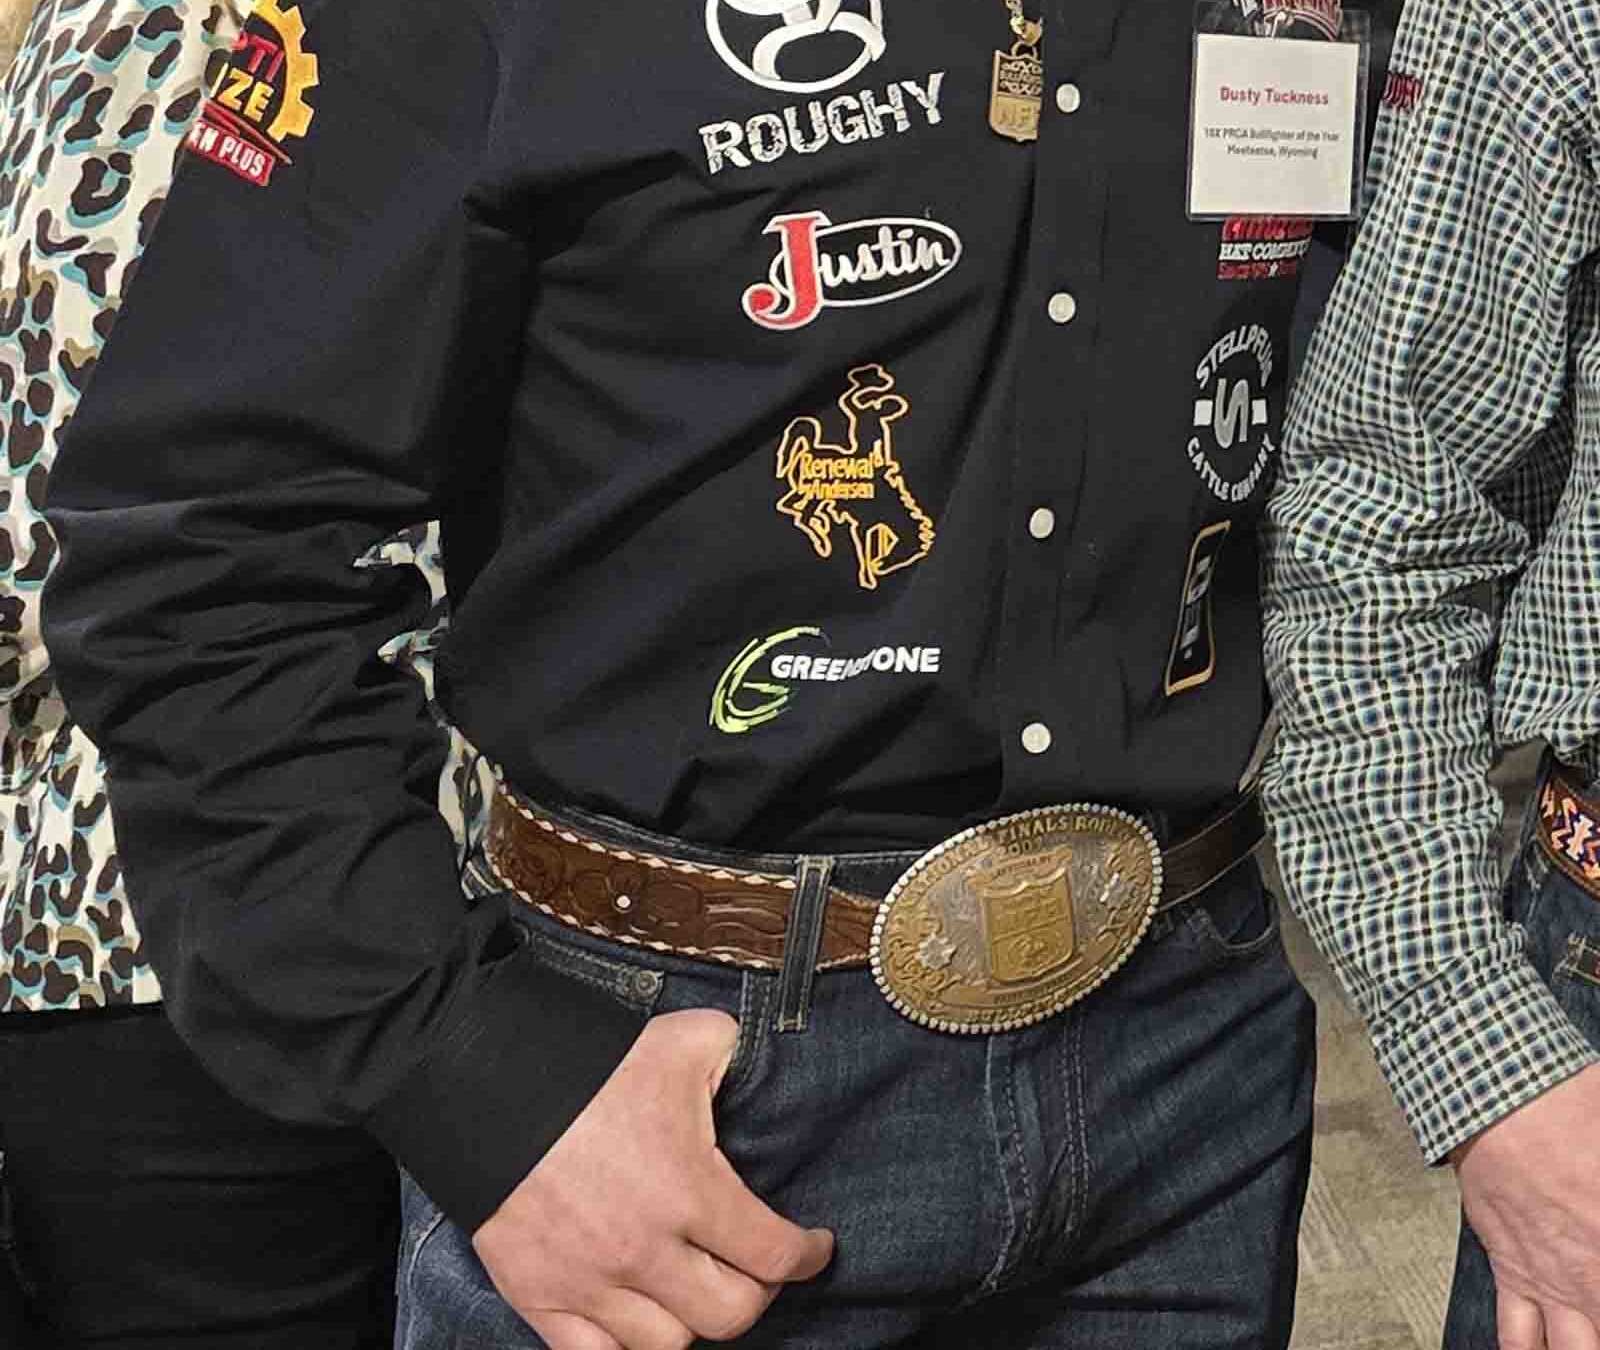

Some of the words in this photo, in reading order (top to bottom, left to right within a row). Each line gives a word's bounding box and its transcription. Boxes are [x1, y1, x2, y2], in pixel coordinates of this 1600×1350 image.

[210, 63, 273, 122] IZE
[1220, 86, 1261, 106] Dusty
[1264, 88, 1329, 105] Tuckness
[699, 72, 945, 175] ROUGHY
[219, 135, 265, 176] PLUS
[741, 210, 950, 330] Justin
[1187, 436, 1229, 502] CATTLE
[1000, 816, 1068, 842] FINALS
